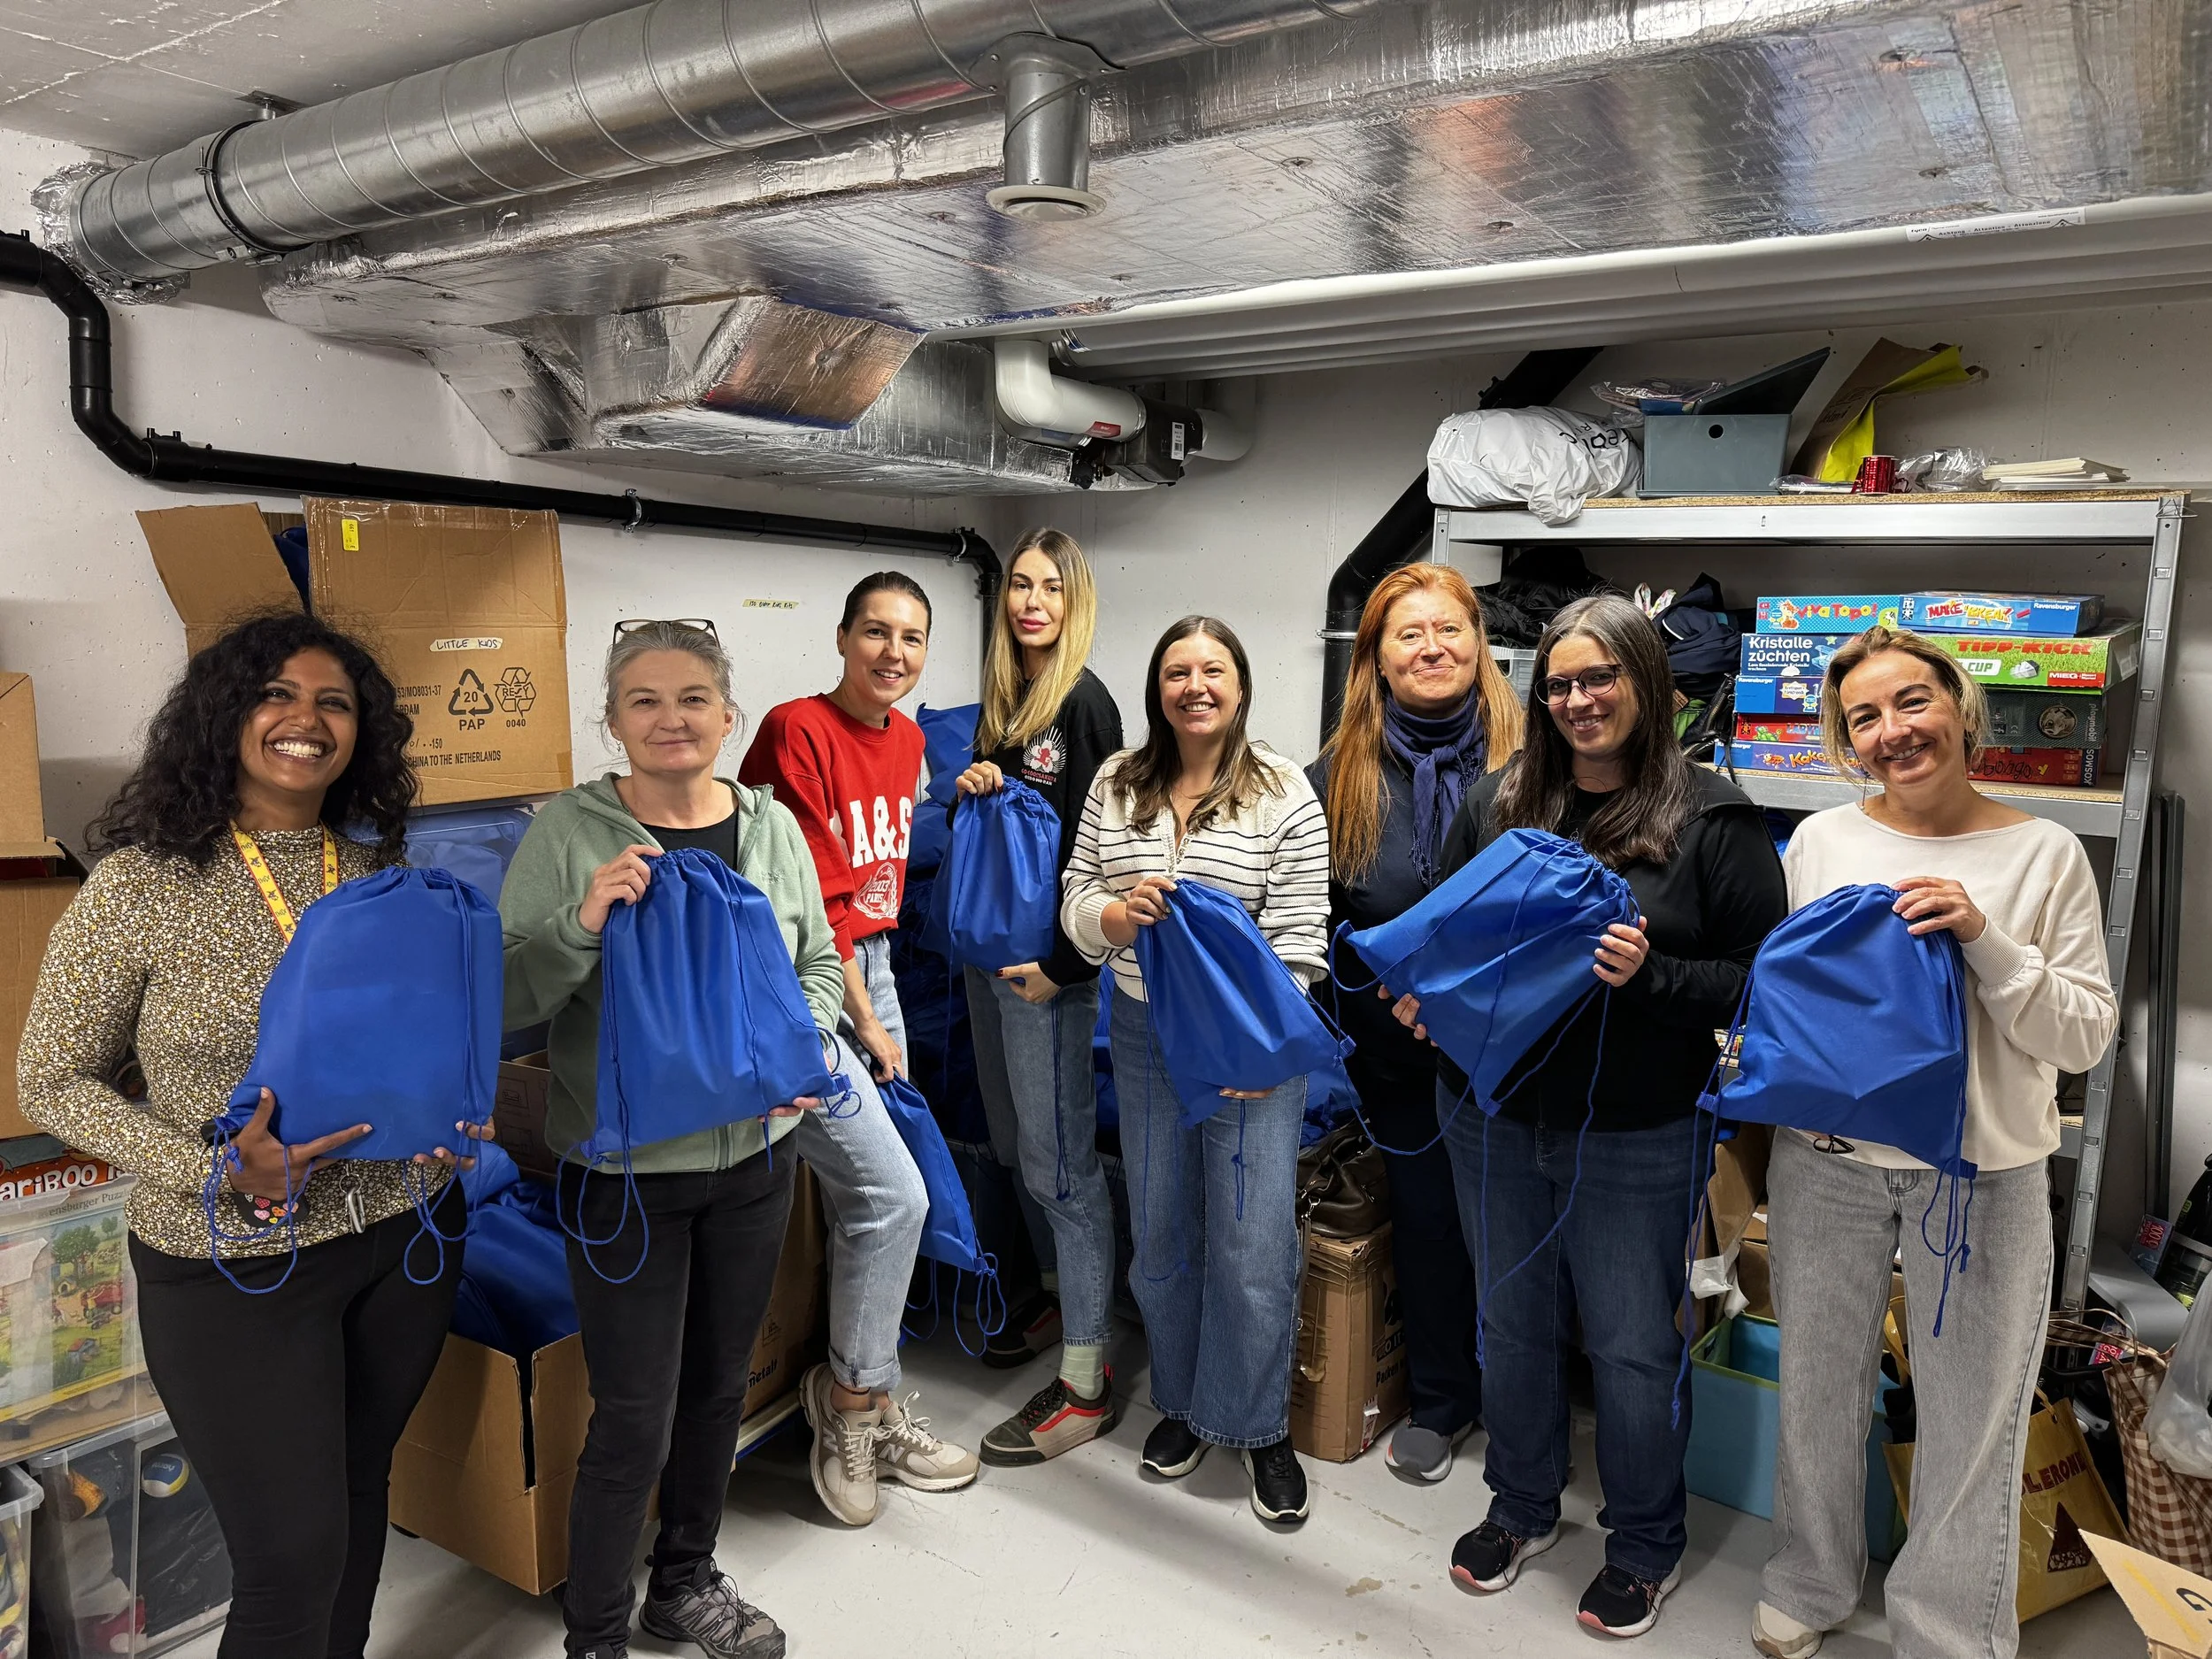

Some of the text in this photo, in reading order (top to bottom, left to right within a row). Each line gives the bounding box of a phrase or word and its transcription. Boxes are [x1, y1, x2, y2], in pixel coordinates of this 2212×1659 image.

[1831, 603, 1878, 622] Topo!
[1928, 601, 1963, 618] MAKE
[1967, 606, 2013, 622] BREAK
[2034, 603, 2077, 611] Ravensburger
[436, 639, 502, 649] LITTLE KIDS
[1749, 636, 1813, 649] Kristalle
[1956, 639, 2093, 656] TIPP-KICK
[1748, 650, 1810, 663] züchten
[1967, 662, 1993, 672] CUP
[464, 691, 479, 703] 20
[459, 718, 486, 731] PAP
[505, 718, 526, 728] 0040
[2087, 703, 2100, 742] playmobil
[407, 750, 502, 767] CHINA TO THE NETHERLANDS
[2083, 749, 2095, 787] KOSMOS
[865, 893, 885, 903] PARIS
[1376, 1363, 1399, 1388] Packen
